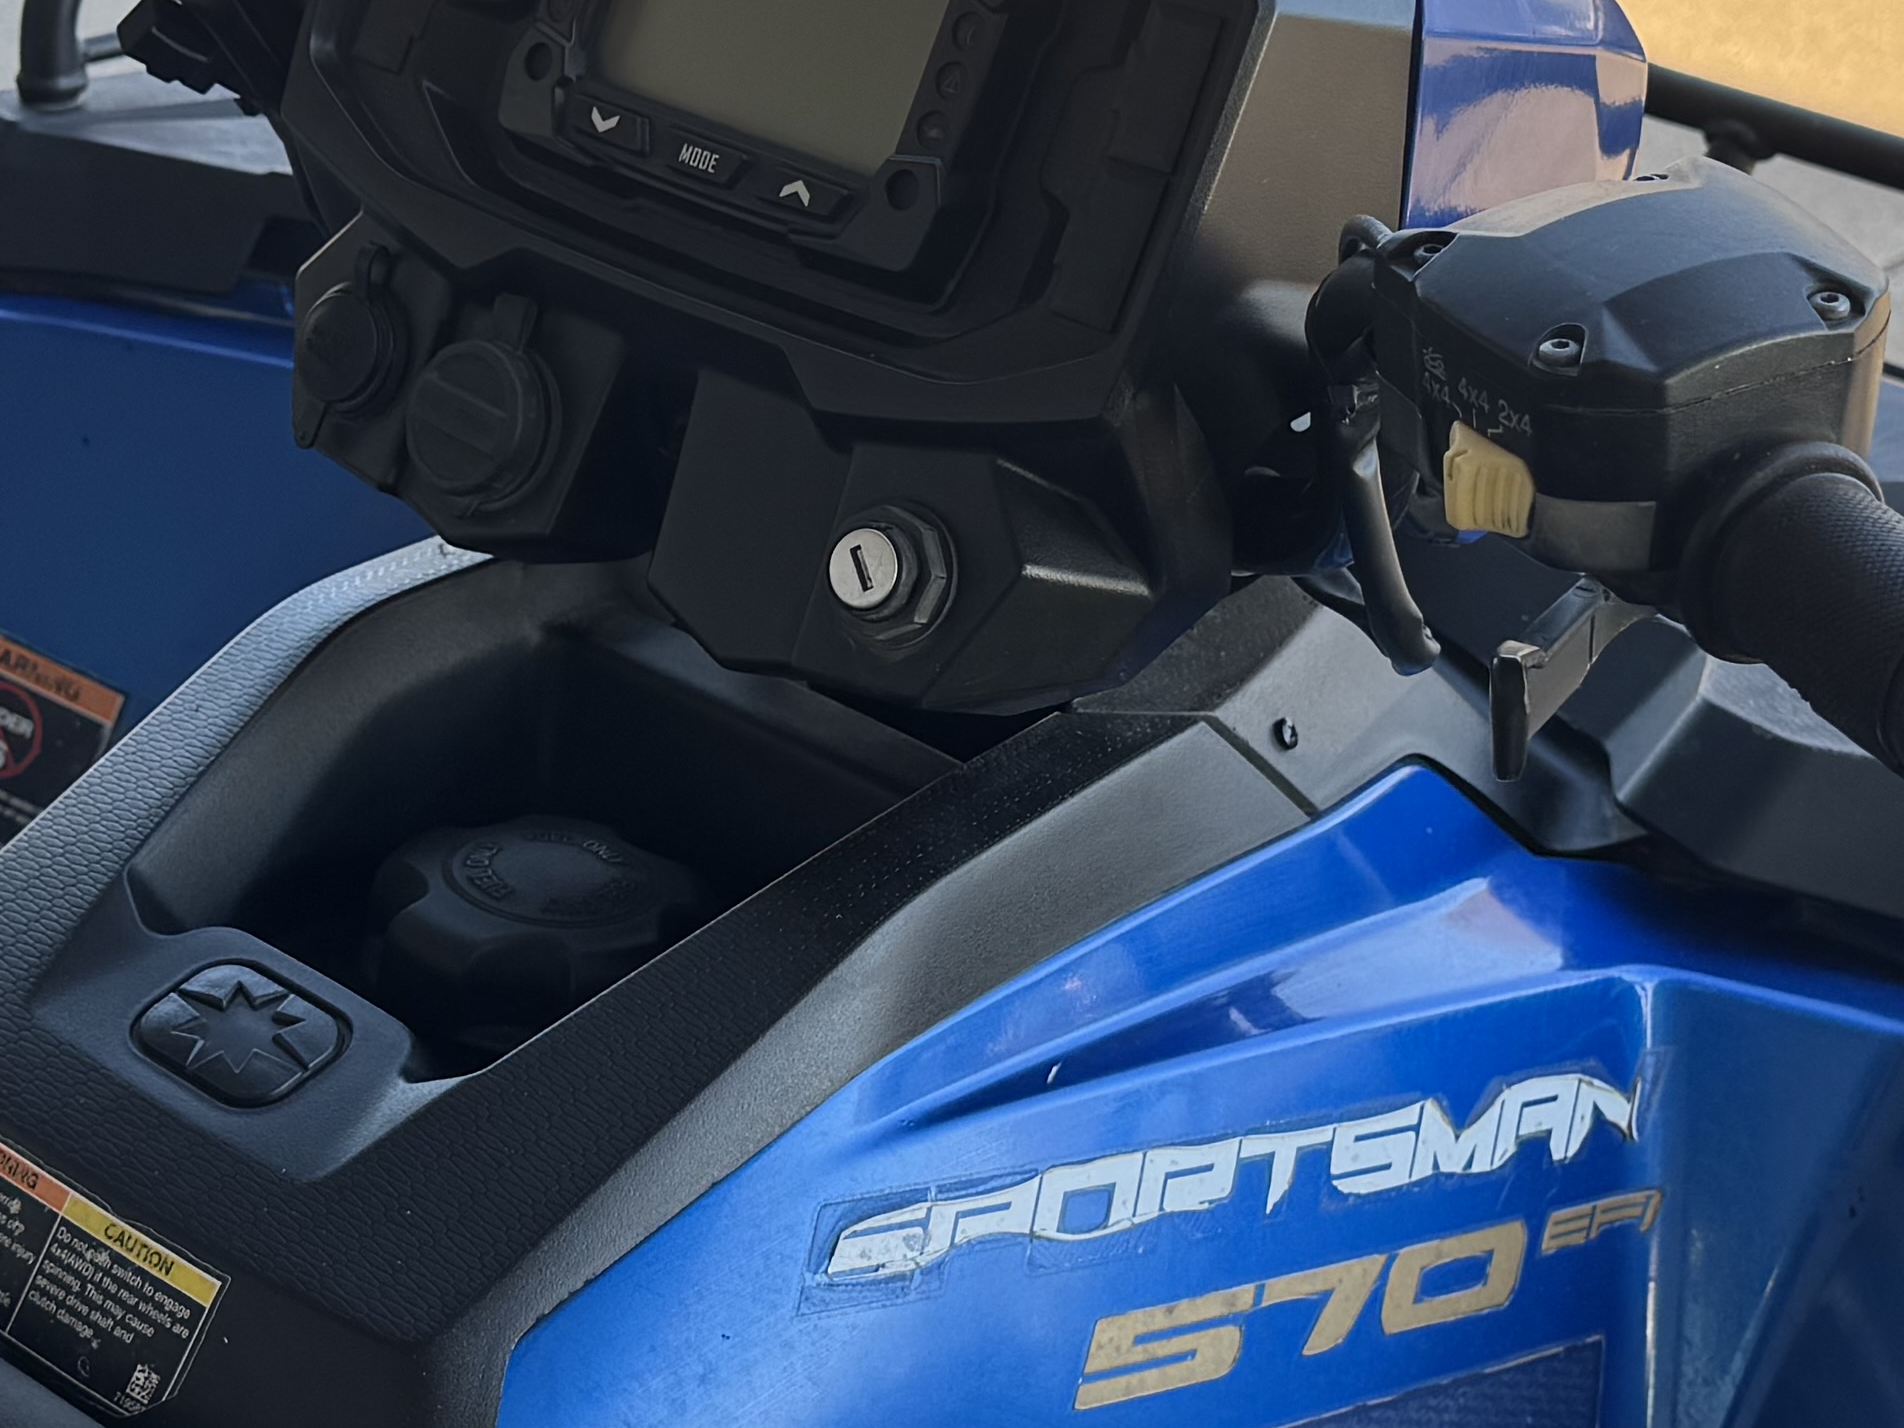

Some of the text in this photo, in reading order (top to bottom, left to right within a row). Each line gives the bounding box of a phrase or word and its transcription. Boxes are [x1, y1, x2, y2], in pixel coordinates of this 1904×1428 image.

[678, 142, 720, 174] MODE
[826, 1073, 1641, 1278] SPORTSMAN
[56, 1226, 71, 1243] Do
[70, 1237, 88, 1255] not
[111, 1264, 142, 1288] switch
[142, 1281, 154, 1296] to
[154, 1291, 190, 1319] engage
[104, 1223, 174, 1275] CAUTION
[28, 1290, 56, 1313] clutch
[35, 1275, 134, 1343] severe drive shaft and
[84, 1283, 103, 1304] This
[103, 1299, 125, 1320] may
[125, 1313, 154, 1336] cause
[101, 1276, 117, 1293] the
[117, 1288, 138, 1305] rear
[138, 1300, 171, 1328] wheels
[171, 1323, 189, 1338] are
[1073, 1190, 1662, 1410] 570 EFI
